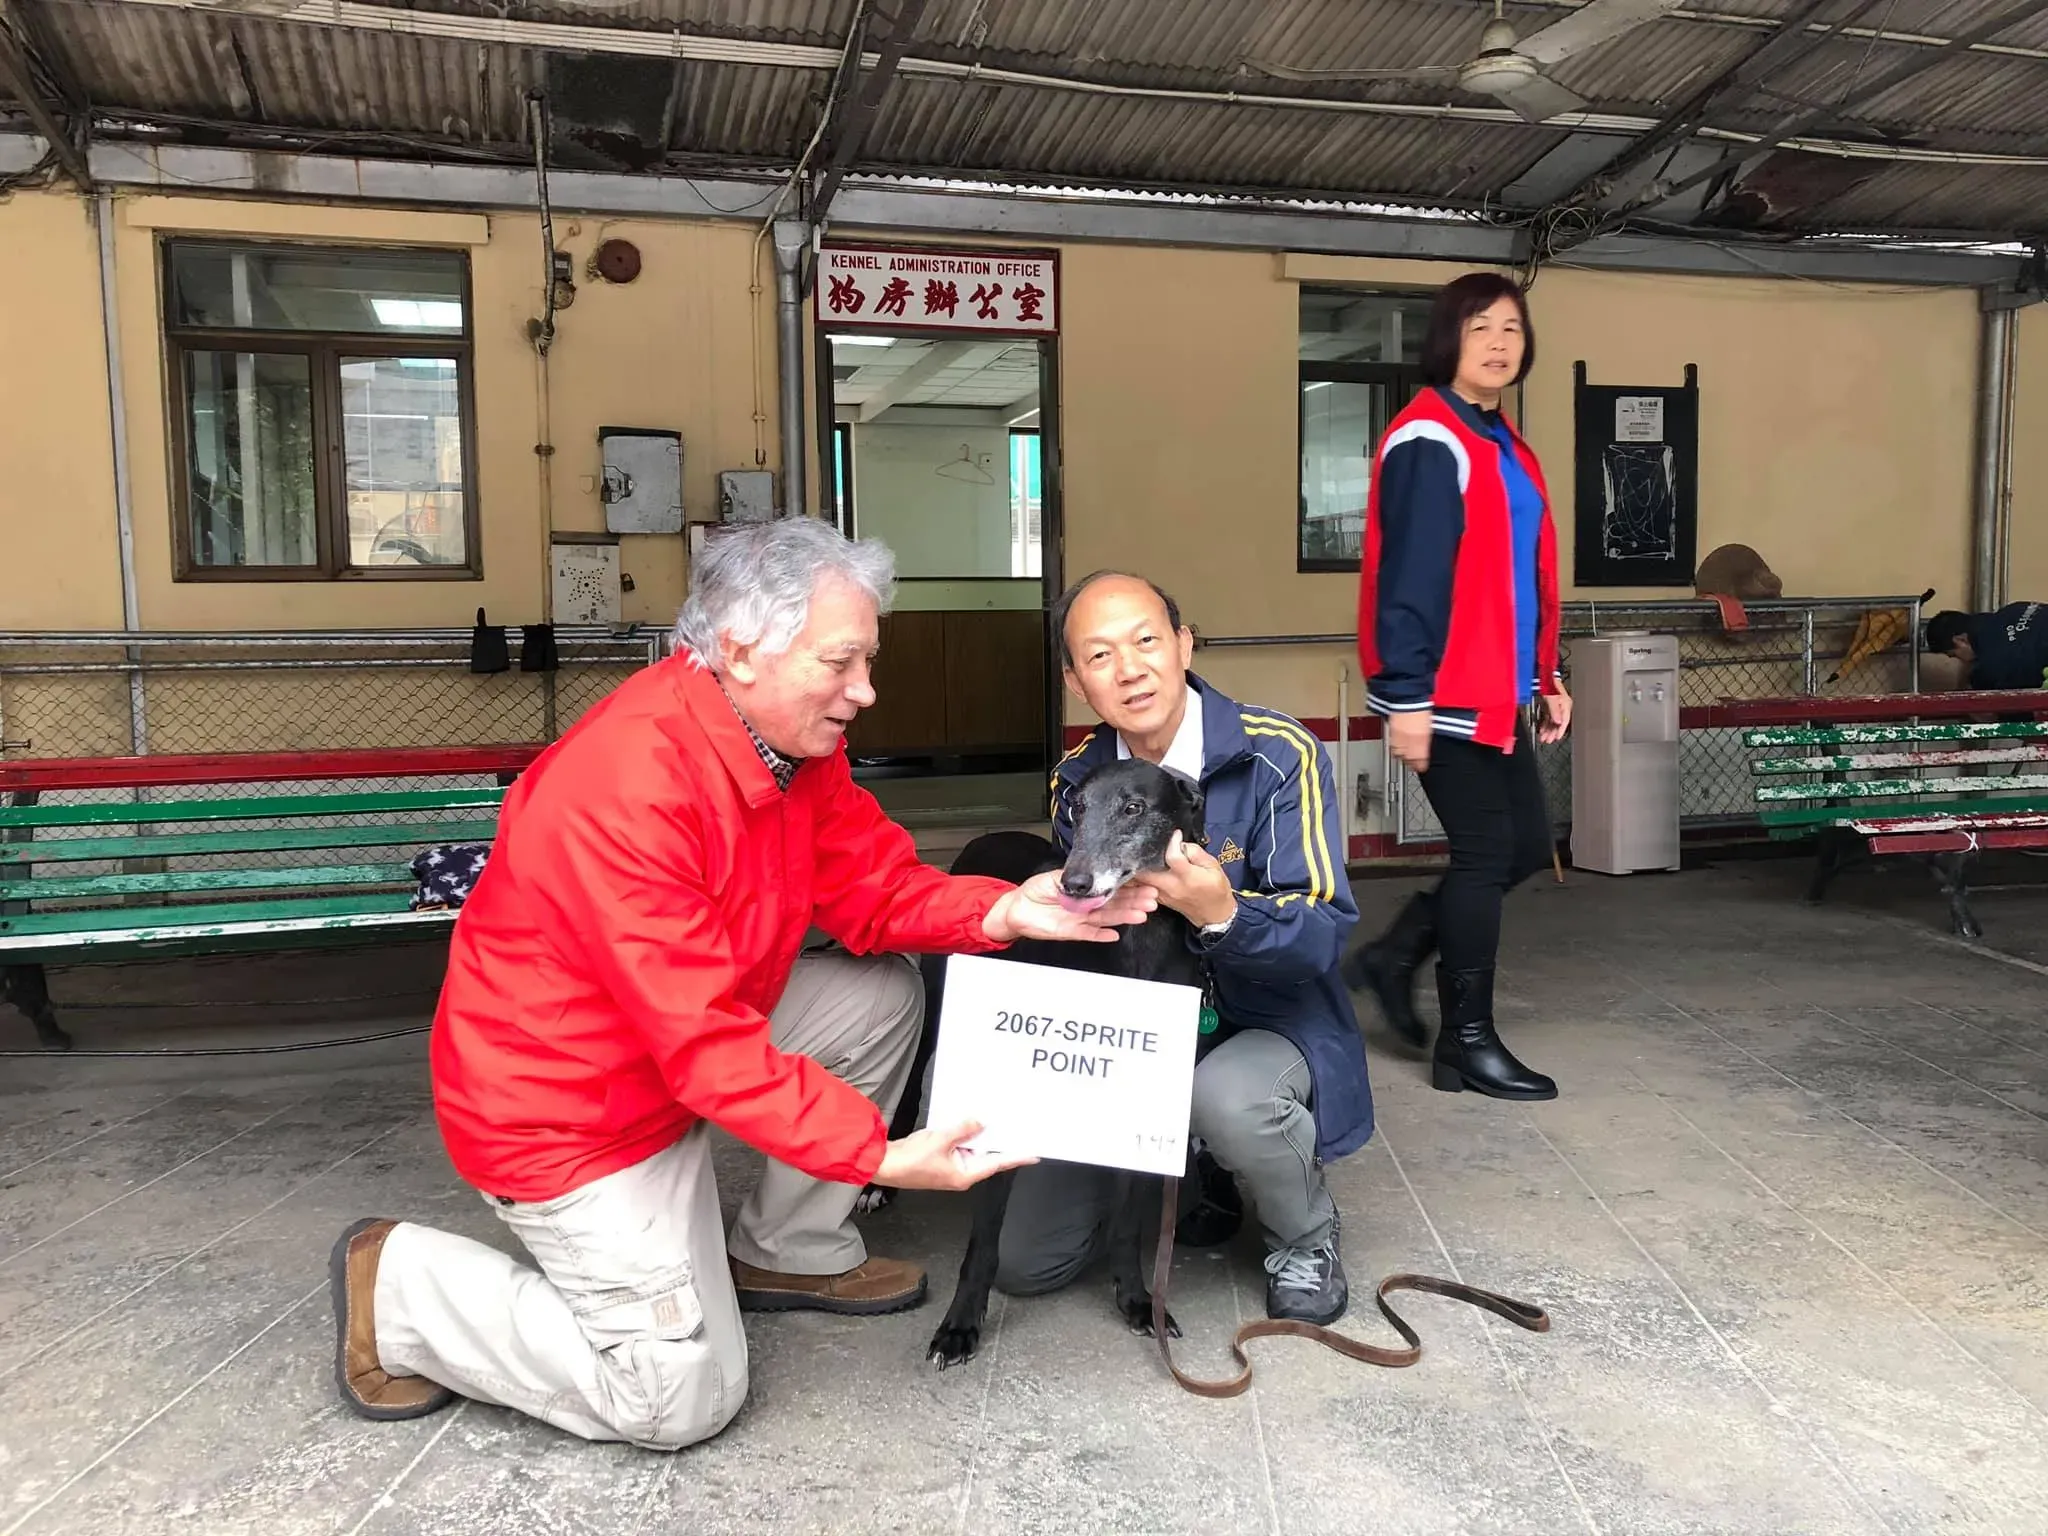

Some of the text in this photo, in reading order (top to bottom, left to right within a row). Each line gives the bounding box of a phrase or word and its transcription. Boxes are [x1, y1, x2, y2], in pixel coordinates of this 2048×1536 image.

[831, 254, 1041, 277] KENNEL ADMINISTRATION OFFICE
[827, 273, 1046, 322] 狗房辦公室
[994, 1010, 1158, 1053] 2067-SPRITE
[1031, 1048, 1115, 1079] POINT
